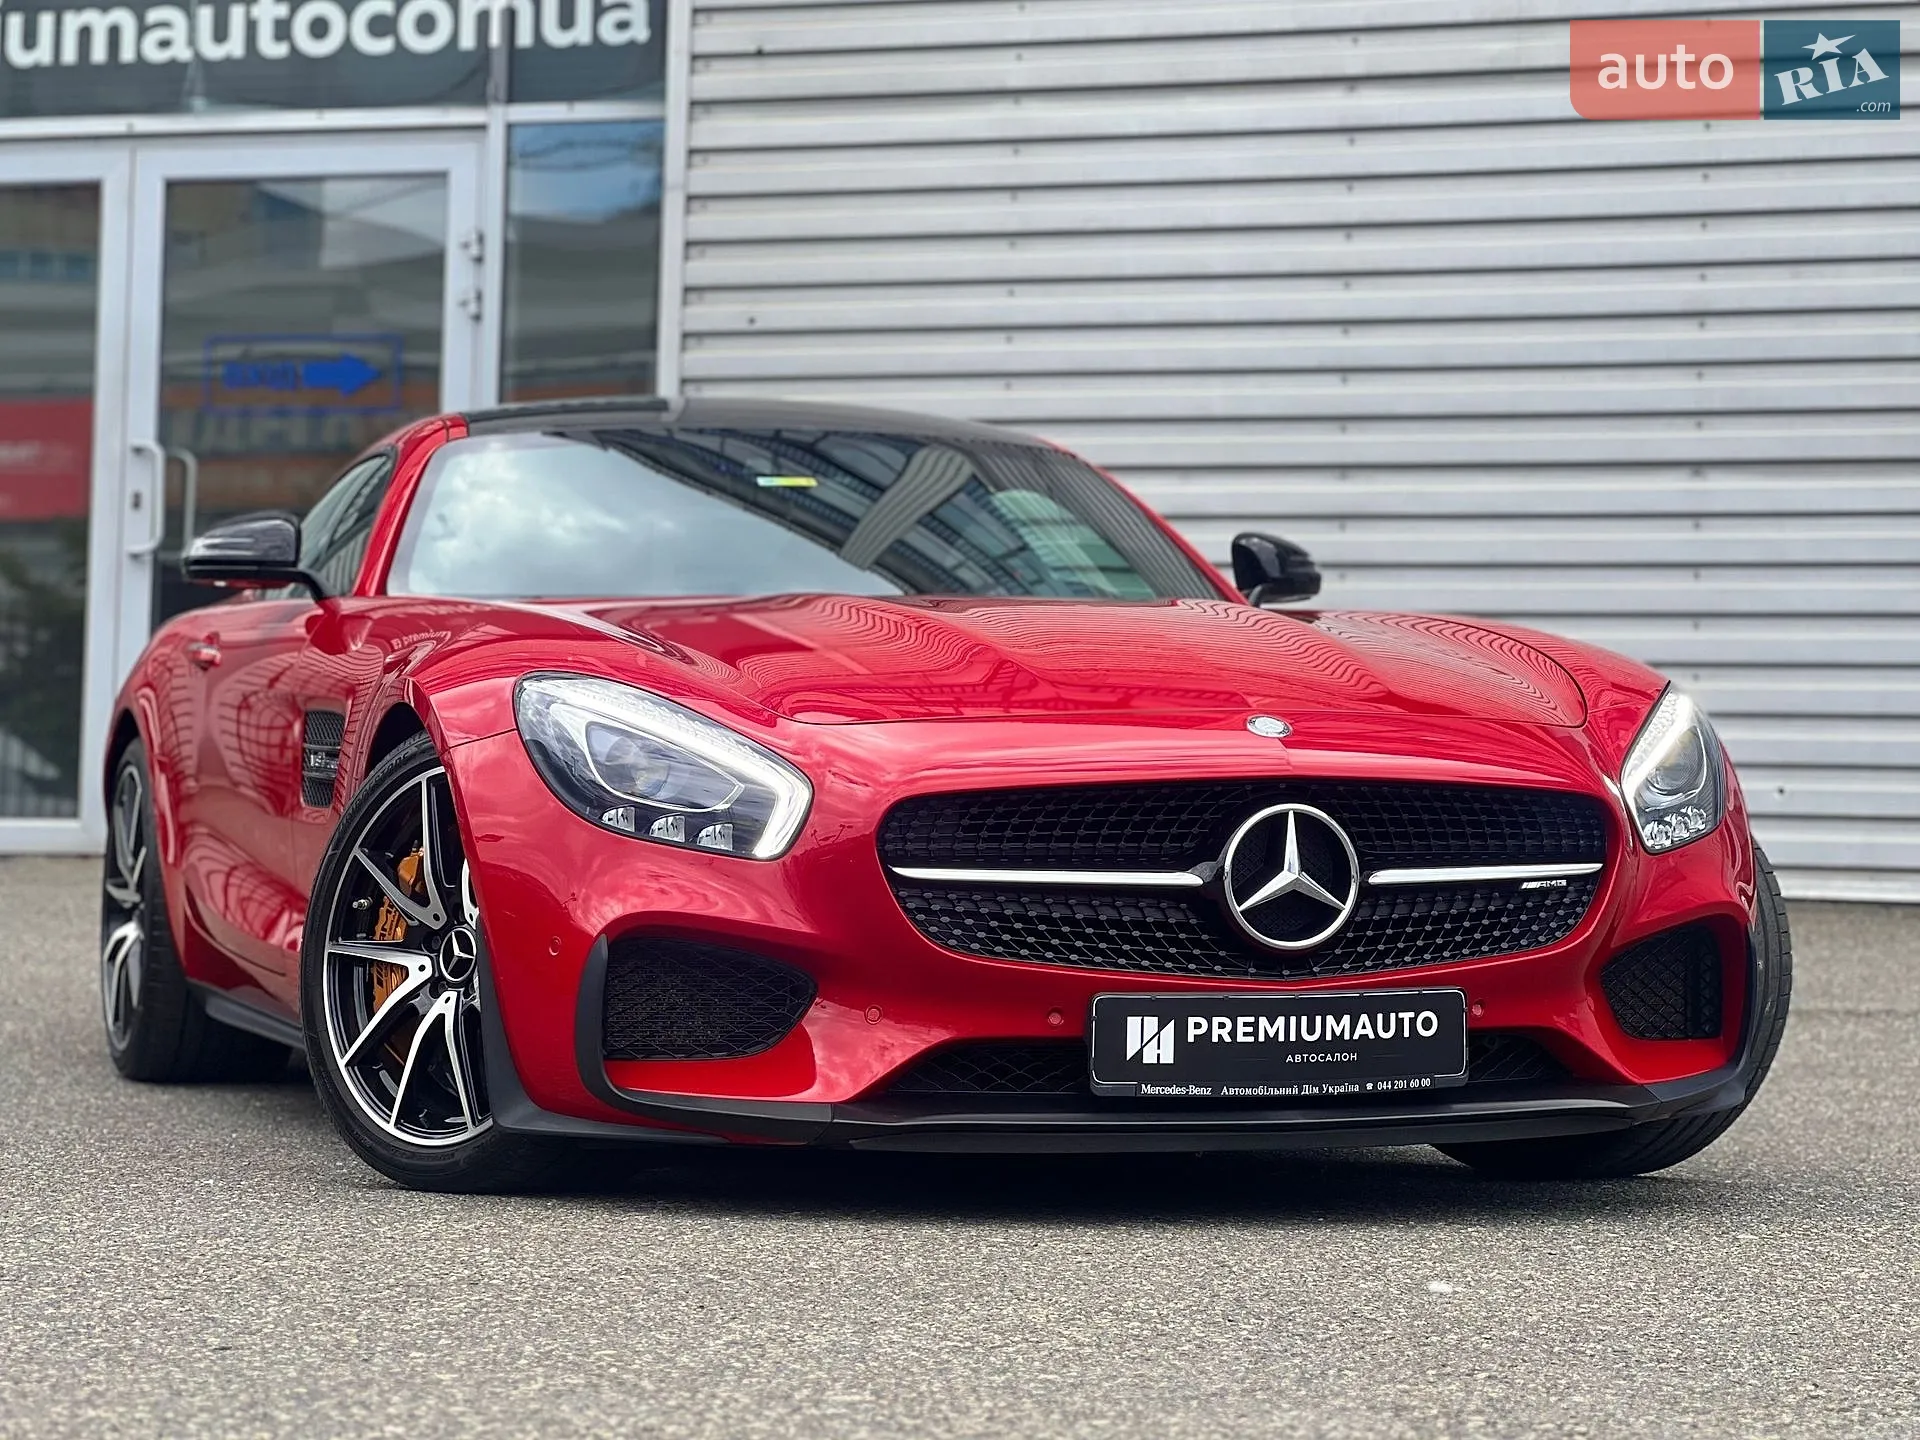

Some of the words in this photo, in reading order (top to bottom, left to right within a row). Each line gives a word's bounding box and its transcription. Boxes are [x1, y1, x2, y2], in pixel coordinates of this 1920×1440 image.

[0, 0, 651, 69] umautocomua
[1187, 1010, 1439, 1043] PREMIUMAUTO
[1285, 1052, 1358, 1063] АВТОСАЛОН
[1140, 1083, 1212, 1095] Mercedes-Benz
[1221, 1084, 1299, 1096] Автомобільний
[1301, 1084, 1319, 1095] Дім
[1322, 1082, 1360, 1096] Україна
[1377, 1081, 1392, 1090] 044
[1394, 1079, 1407, 1089] 201
[1409, 1078, 1420, 1088] 60
[1421, 1077, 1431, 1087] 00
